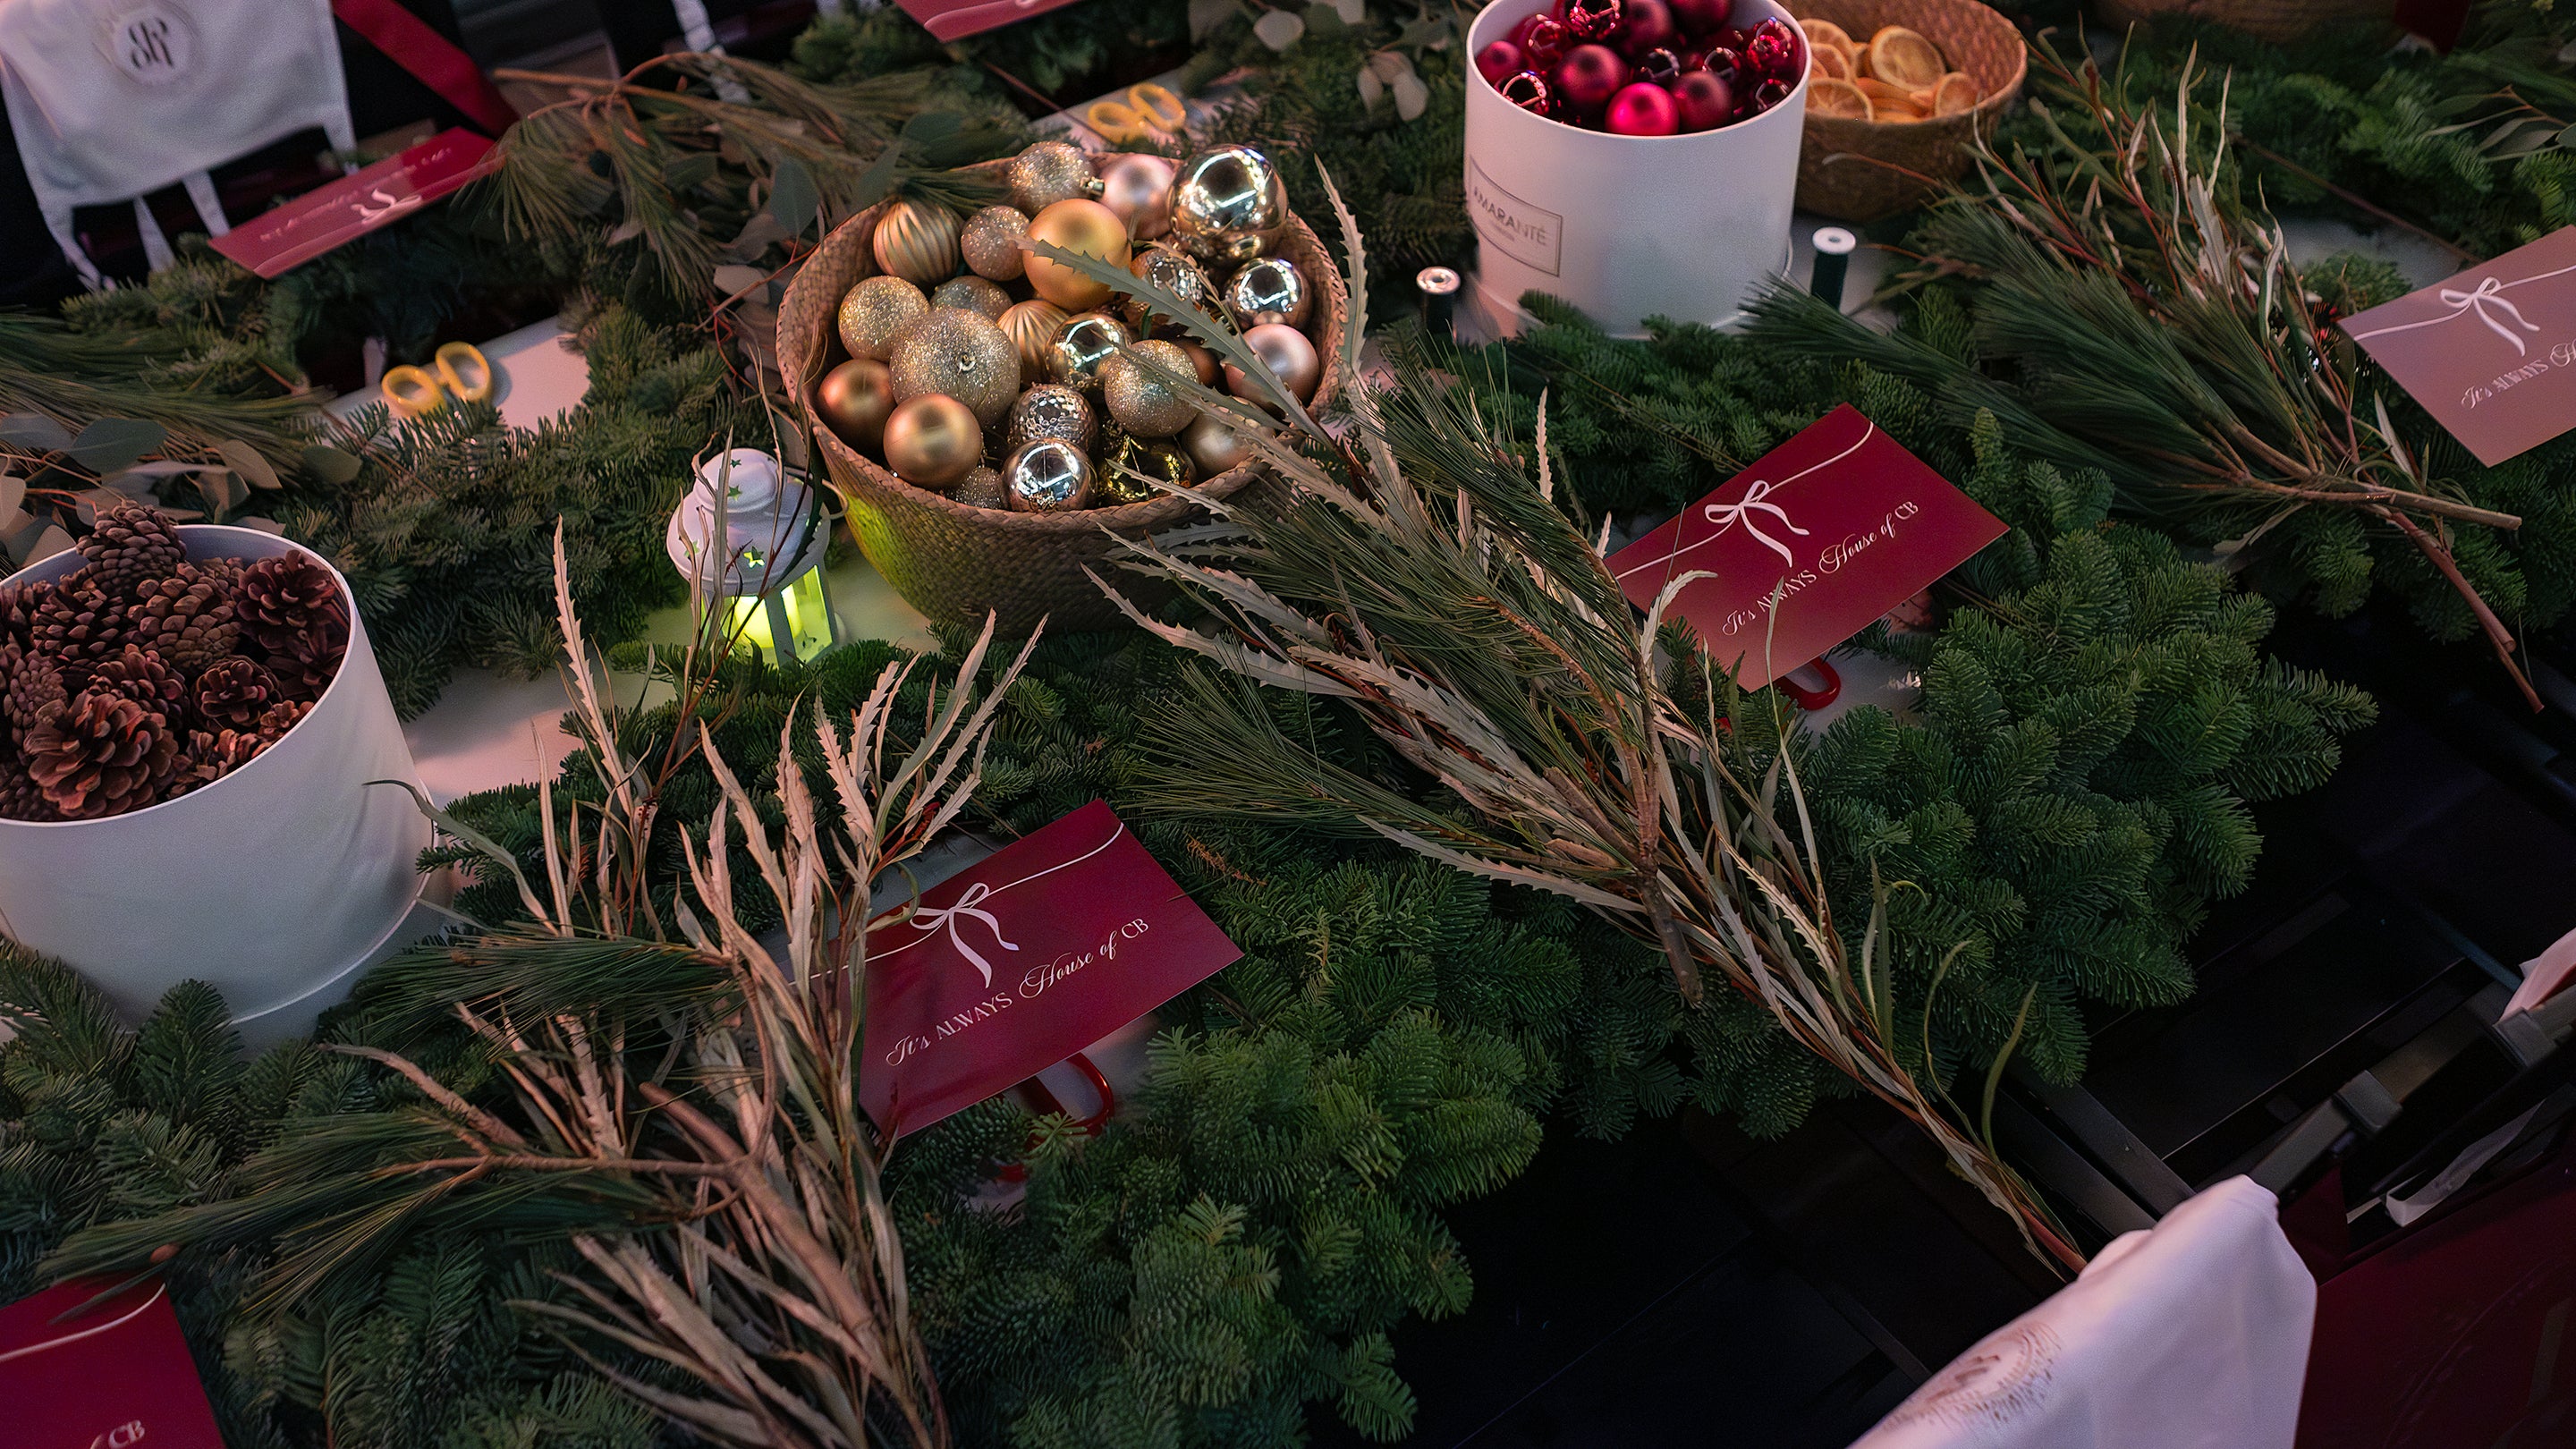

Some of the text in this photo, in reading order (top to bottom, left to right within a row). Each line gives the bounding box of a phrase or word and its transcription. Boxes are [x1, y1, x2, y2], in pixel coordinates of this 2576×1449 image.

[2461, 359, 2549, 410] It's ALWAYS
[1722, 609, 1756, 636] It's
[1818, 533, 1877, 574] House
[1880, 513, 1897, 538] of
[1894, 500, 1919, 521] CB
[886, 918, 1149, 1066] It's ALWAYS House of CB
[108, 1419, 146, 1449] CB
